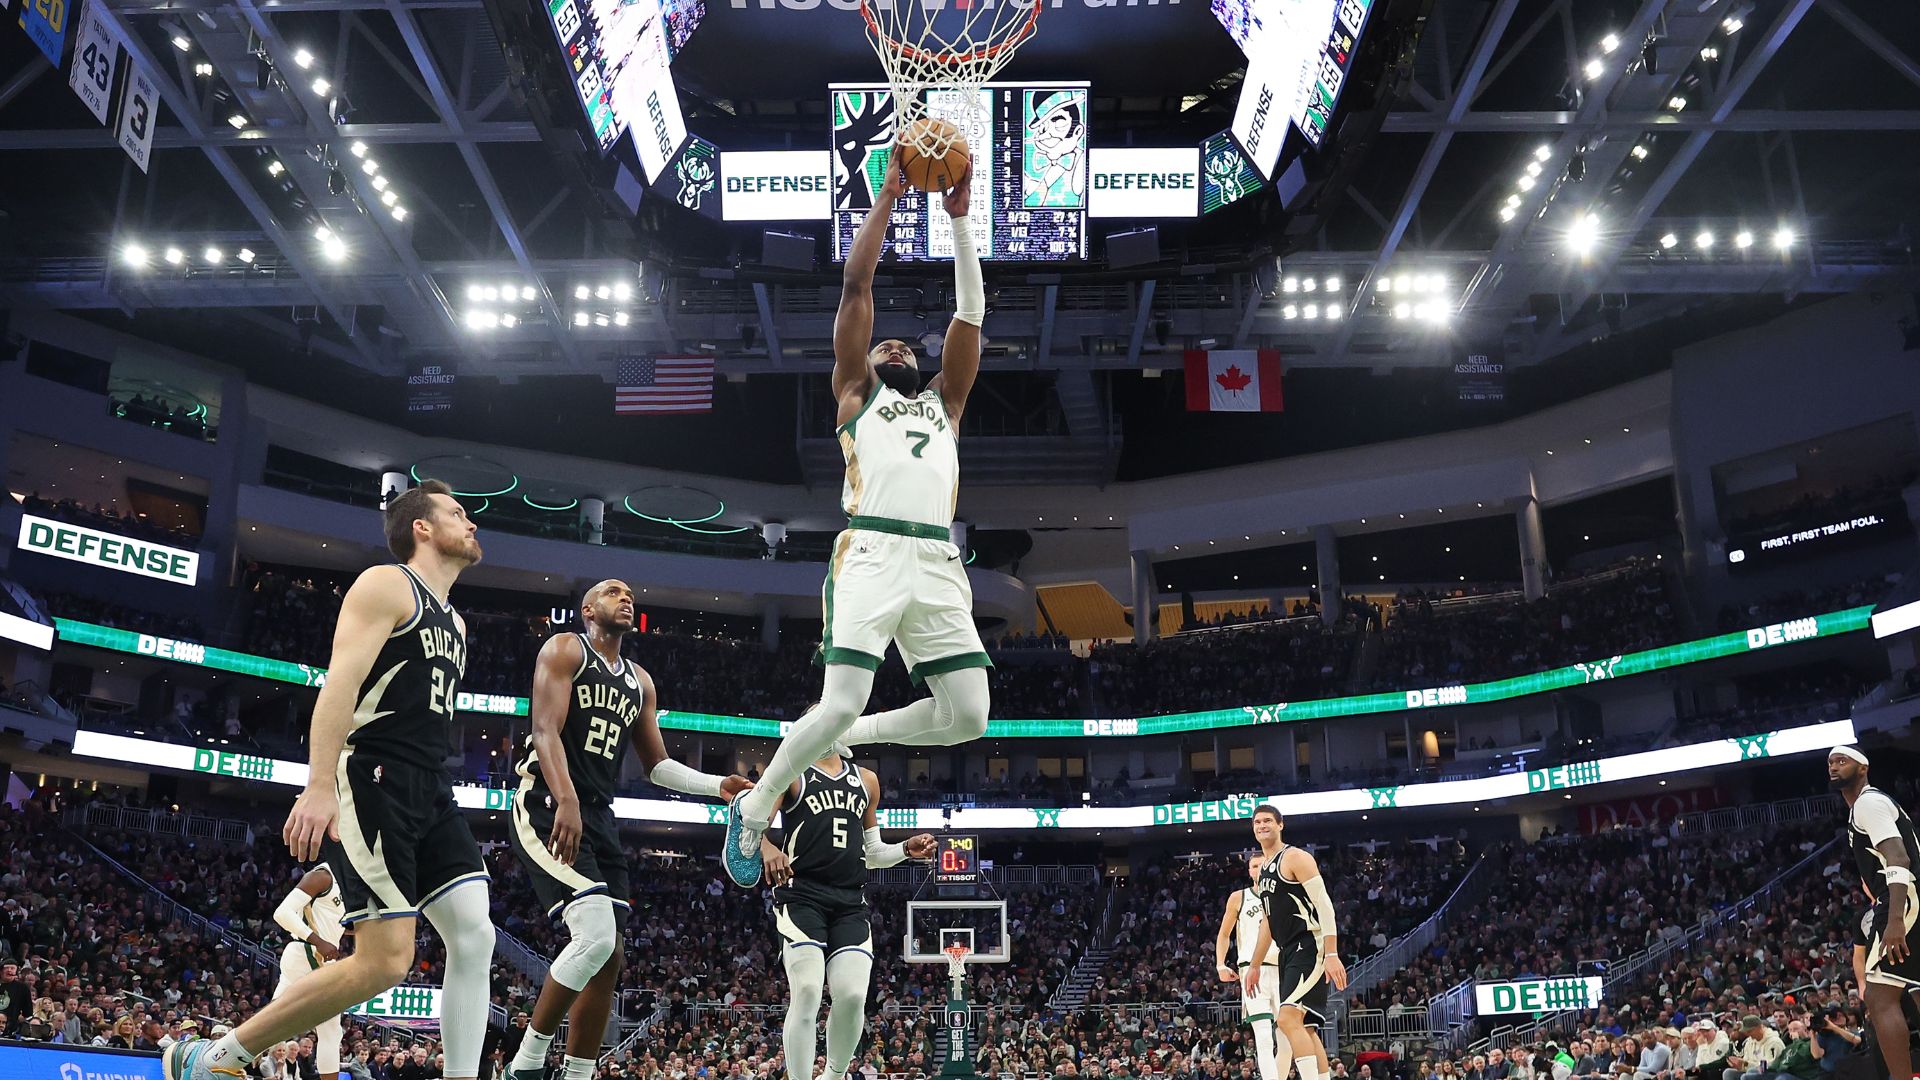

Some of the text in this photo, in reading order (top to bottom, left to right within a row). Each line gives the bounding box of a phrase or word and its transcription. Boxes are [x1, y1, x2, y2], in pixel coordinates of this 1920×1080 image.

[93, 20, 111, 48] TATUM
[82, 42, 110, 92] 43
[130, 94, 149, 141] 3
[646, 89, 673, 162] DEFENSE
[1246, 83, 1274, 156] DEFENSE
[727, 175, 828, 193] DEFENSE
[1094, 172, 1195, 190] DEFENSE
[422, 366, 441, 375] NEED
[1455, 364, 1503, 373] ASSISTANCE?
[1468, 355, 1488, 364] NEED
[408, 375, 455, 385] ASSISTANCE?
[876, 400, 946, 432] BOSTON
[906, 430, 931, 459] 7
[1761, 535, 1792, 550] FIRST,
[1792, 528, 1821, 544] FIRST
[1821, 521, 1850, 536] TEAM
[1850, 515, 1879, 530] FOUL
[28, 522, 191, 579] DEFENSE
[419, 626, 466, 680] BUCKS
[429, 666, 455, 721] 24
[576, 684, 638, 727] BUCKS
[584, 716, 621, 760] 22
[805, 789, 867, 827] BUCKS
[832, 817, 848, 849] 5
[948, 838, 973, 850] 7:40
[951, 1029, 963, 1040] GET
[951, 1040, 964, 1051] THE
[951, 1051, 964, 1062] APP
